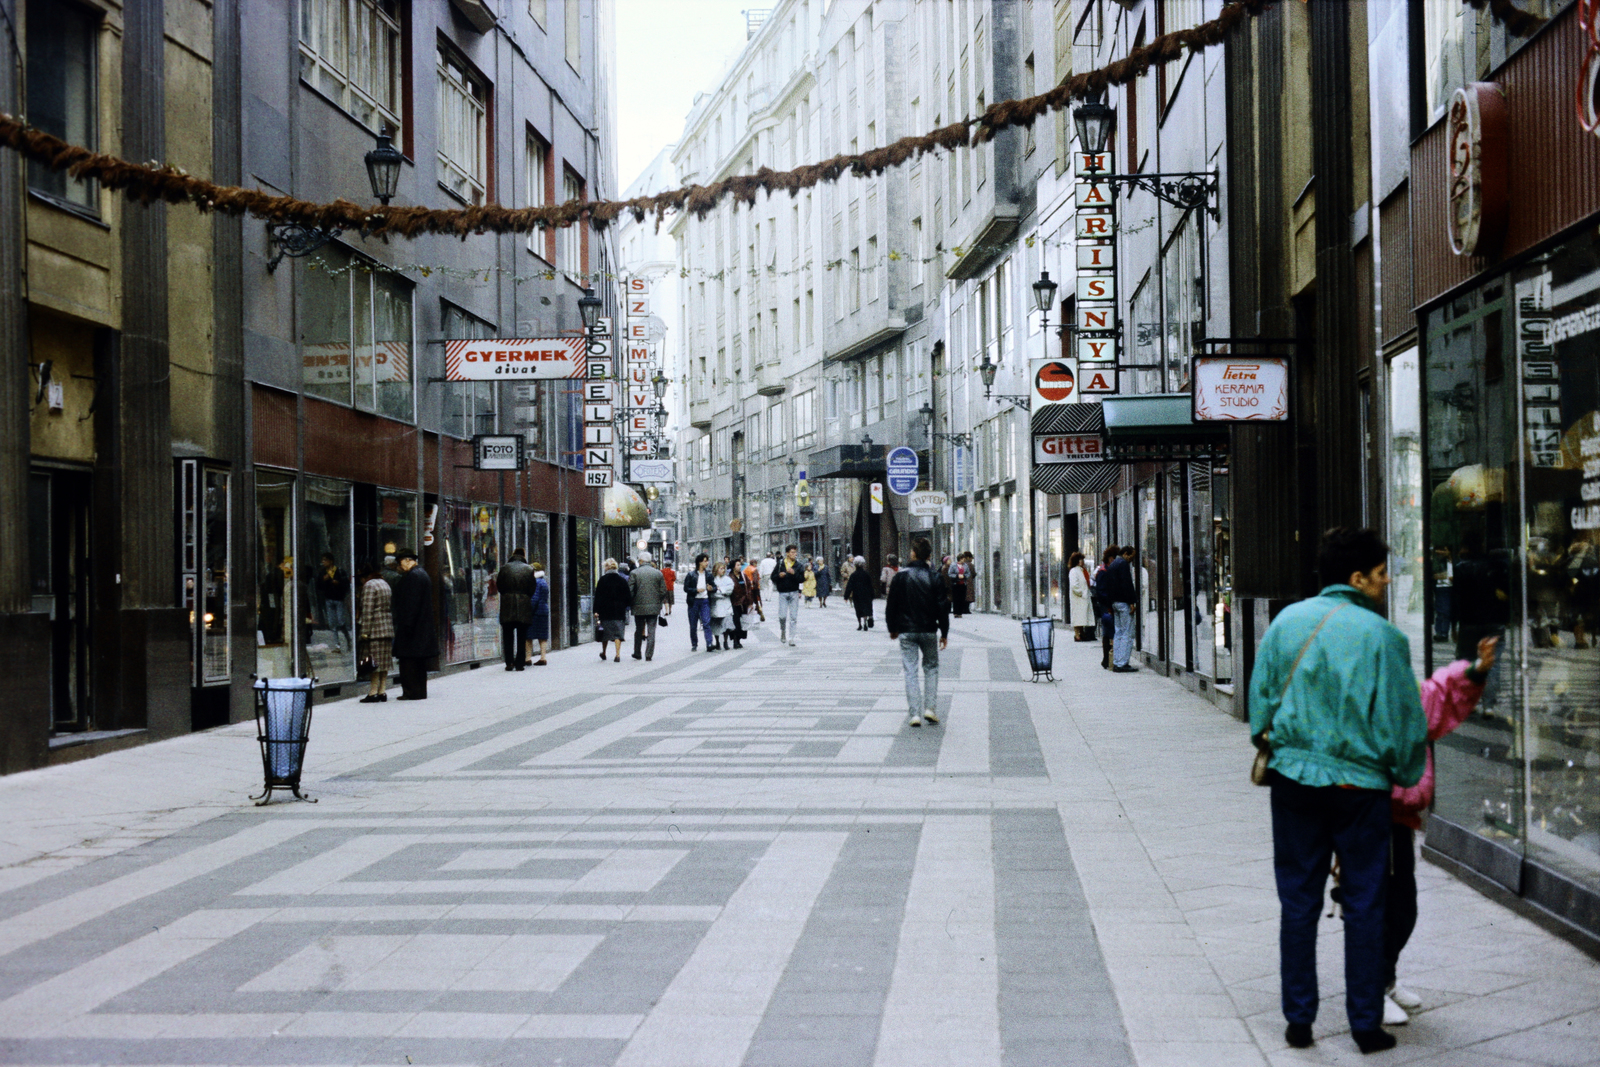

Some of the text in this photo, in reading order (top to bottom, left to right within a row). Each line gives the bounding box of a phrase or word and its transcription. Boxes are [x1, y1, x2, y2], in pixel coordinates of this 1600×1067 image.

[1082, 155, 1110, 389] HARISNYA
[465, 350, 568, 362] GYERMEK
[495, 363, 537, 375] divat
[631, 279, 647, 452] SZEMÜVEG
[1222, 364, 1261, 380] Pietra
[588, 320, 608, 464] GOBELIN
[1214, 382, 1265, 394] KERÁMIA
[483, 445, 514, 459] FOTO
[1042, 437, 1099, 454] Gitta
[587, 472, 607, 485] HSZ
